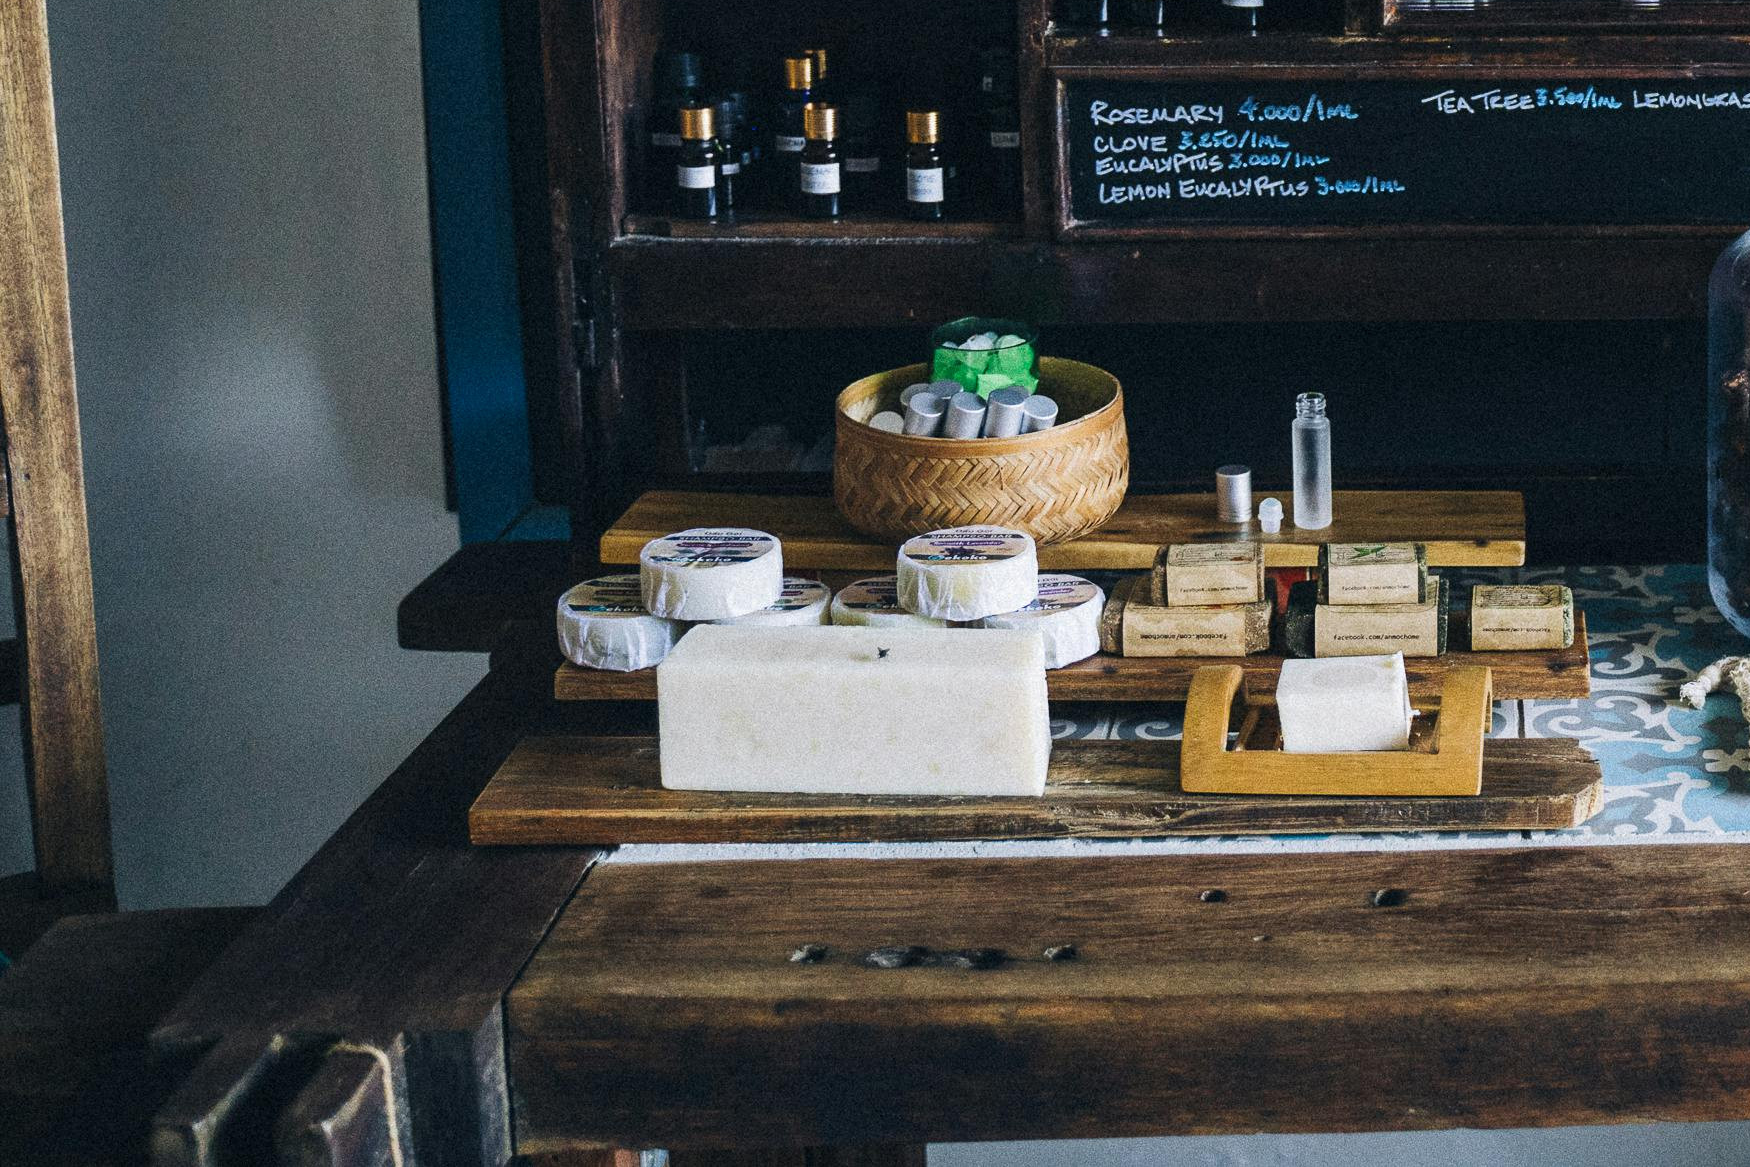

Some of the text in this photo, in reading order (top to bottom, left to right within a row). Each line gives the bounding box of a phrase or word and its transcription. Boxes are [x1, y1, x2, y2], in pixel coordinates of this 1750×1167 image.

[1091, 100, 1223, 125] ROSEMARY
[1421, 89, 1474, 113] TEA
[1471, 89, 1535, 111] TREE
[1094, 136, 1168, 153] CLOVE
[1096, 152, 1223, 175] EUCALYPTUS
[1100, 182, 1171, 204] LEMON
[1179, 175, 1309, 198] EUCALYPTUS
